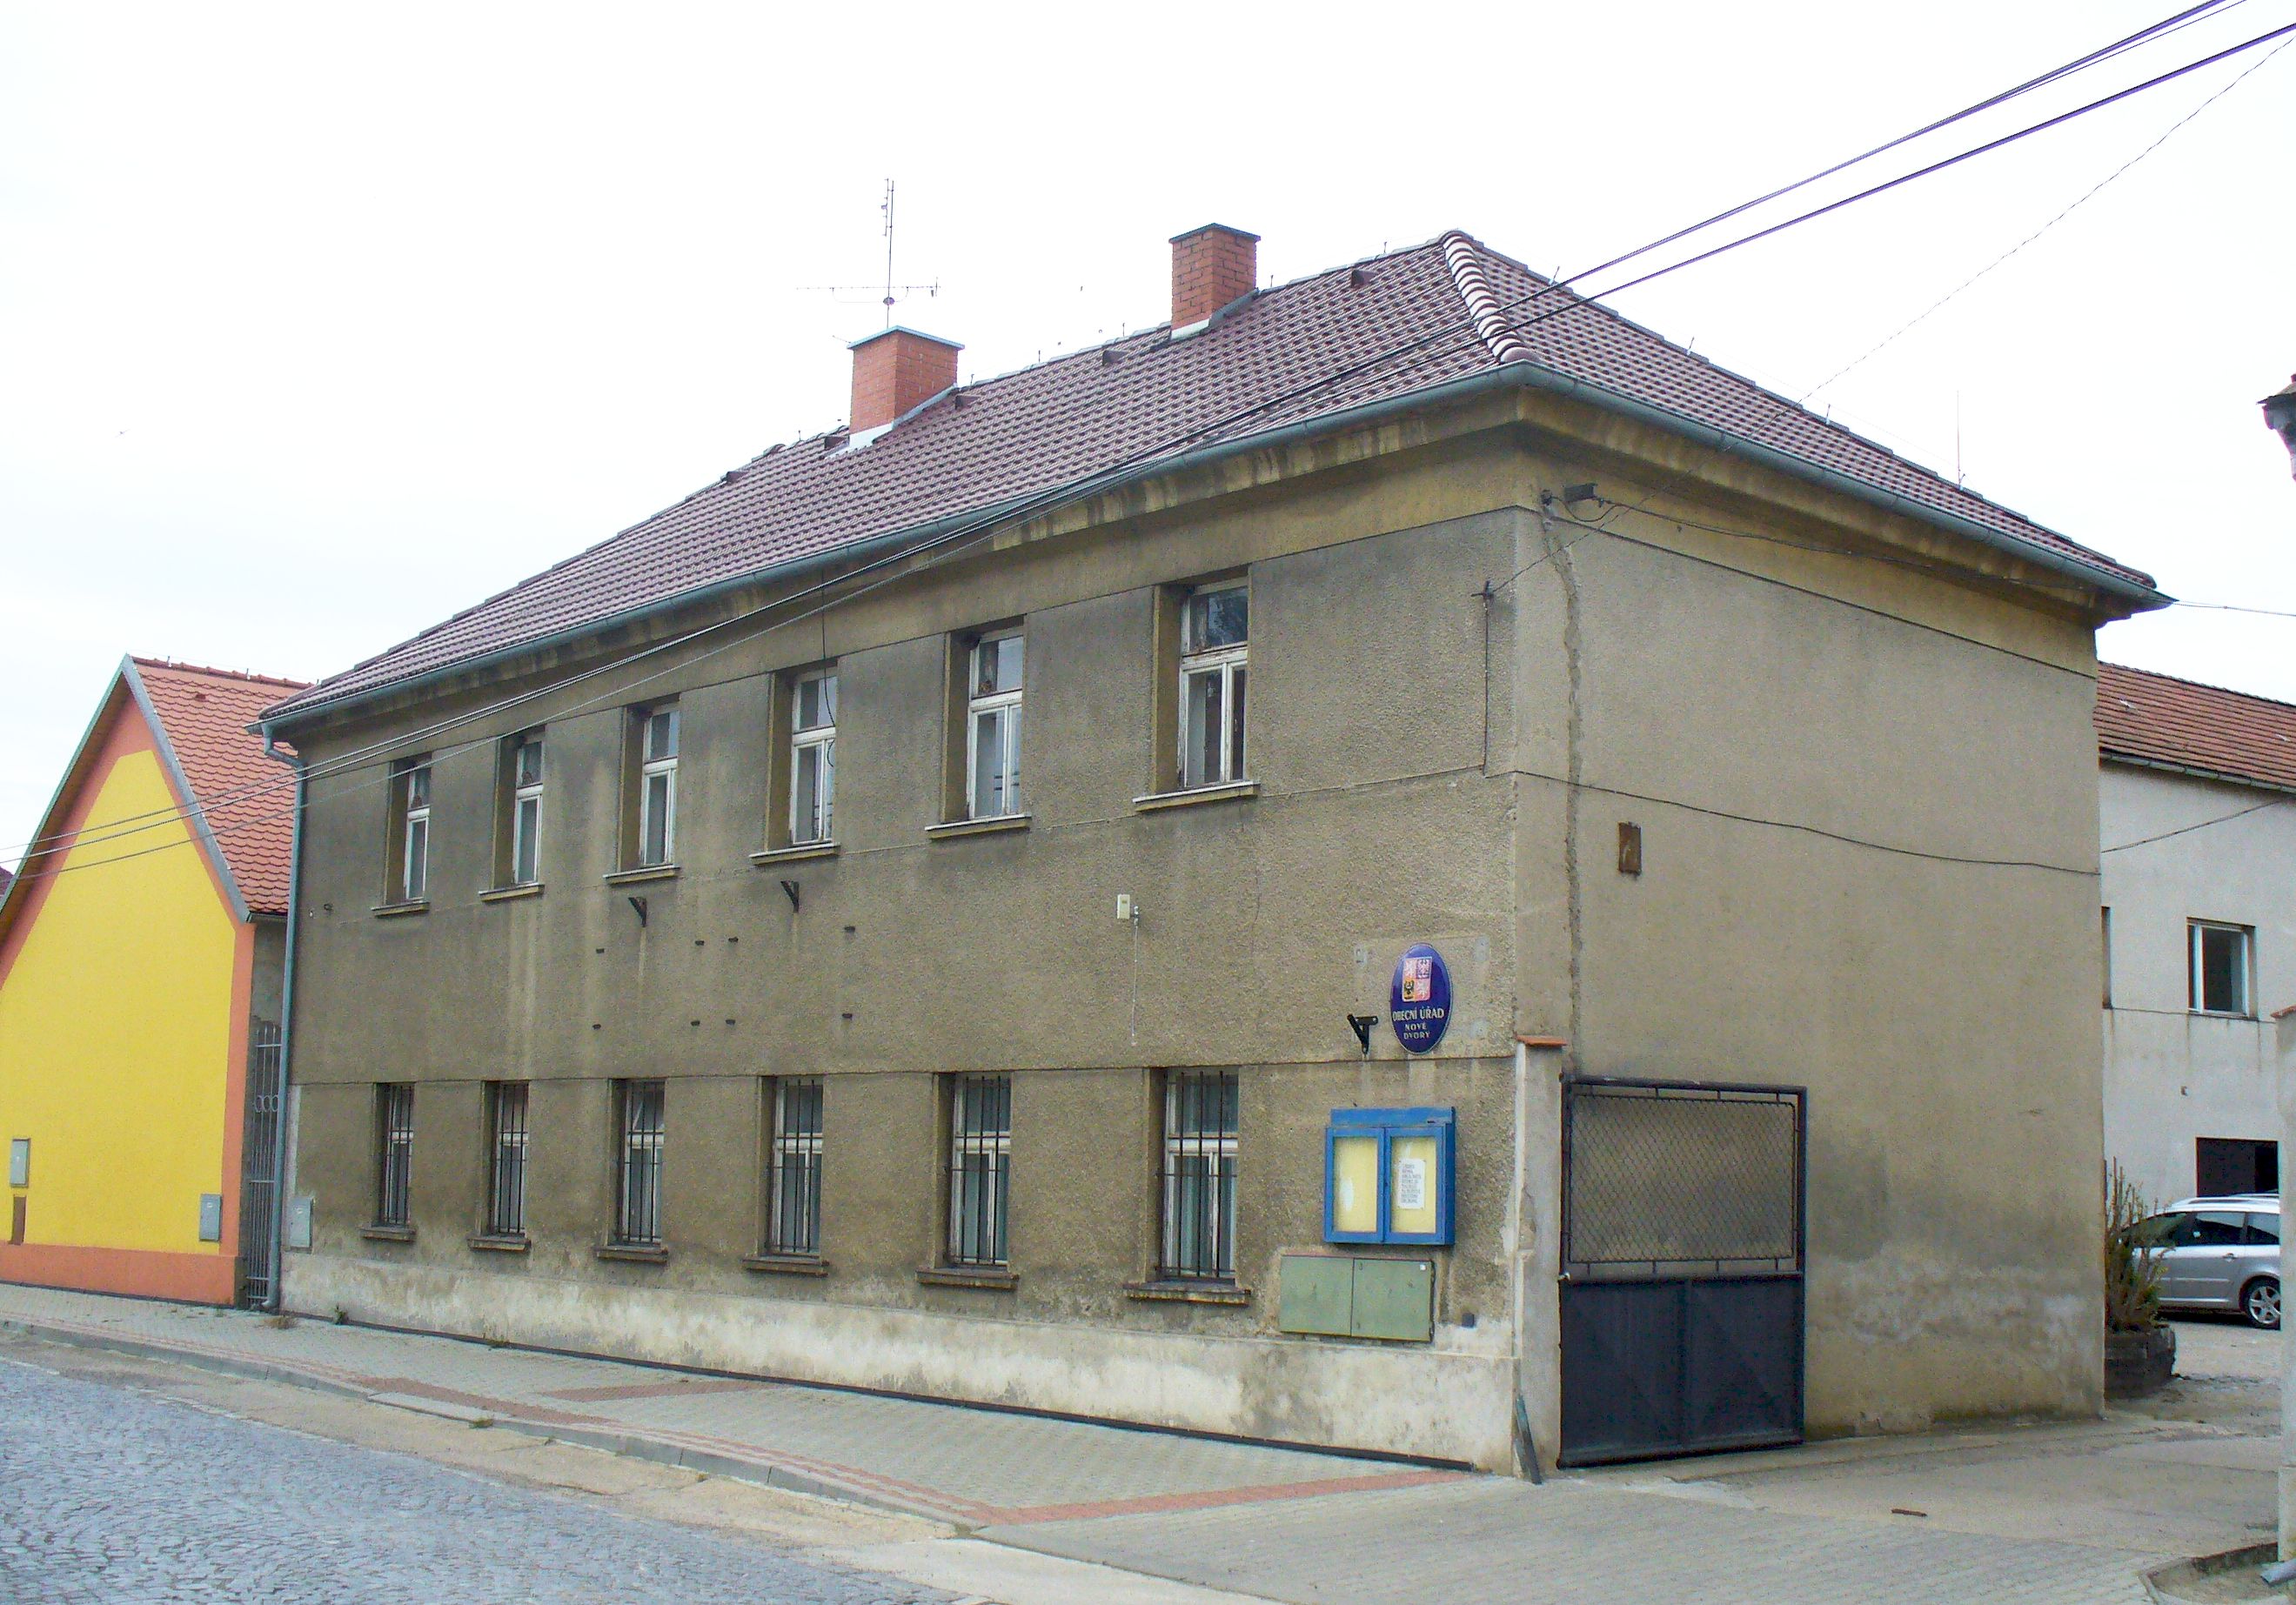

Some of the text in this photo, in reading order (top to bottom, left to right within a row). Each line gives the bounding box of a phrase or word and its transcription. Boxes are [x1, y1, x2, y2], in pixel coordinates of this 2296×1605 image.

[1392, 1006, 1444, 1021] OBECNÍ ÚŘAD
[1405, 1021, 1427, 1031] NOVÉ
[1403, 1031, 1430, 1040] DVORY
